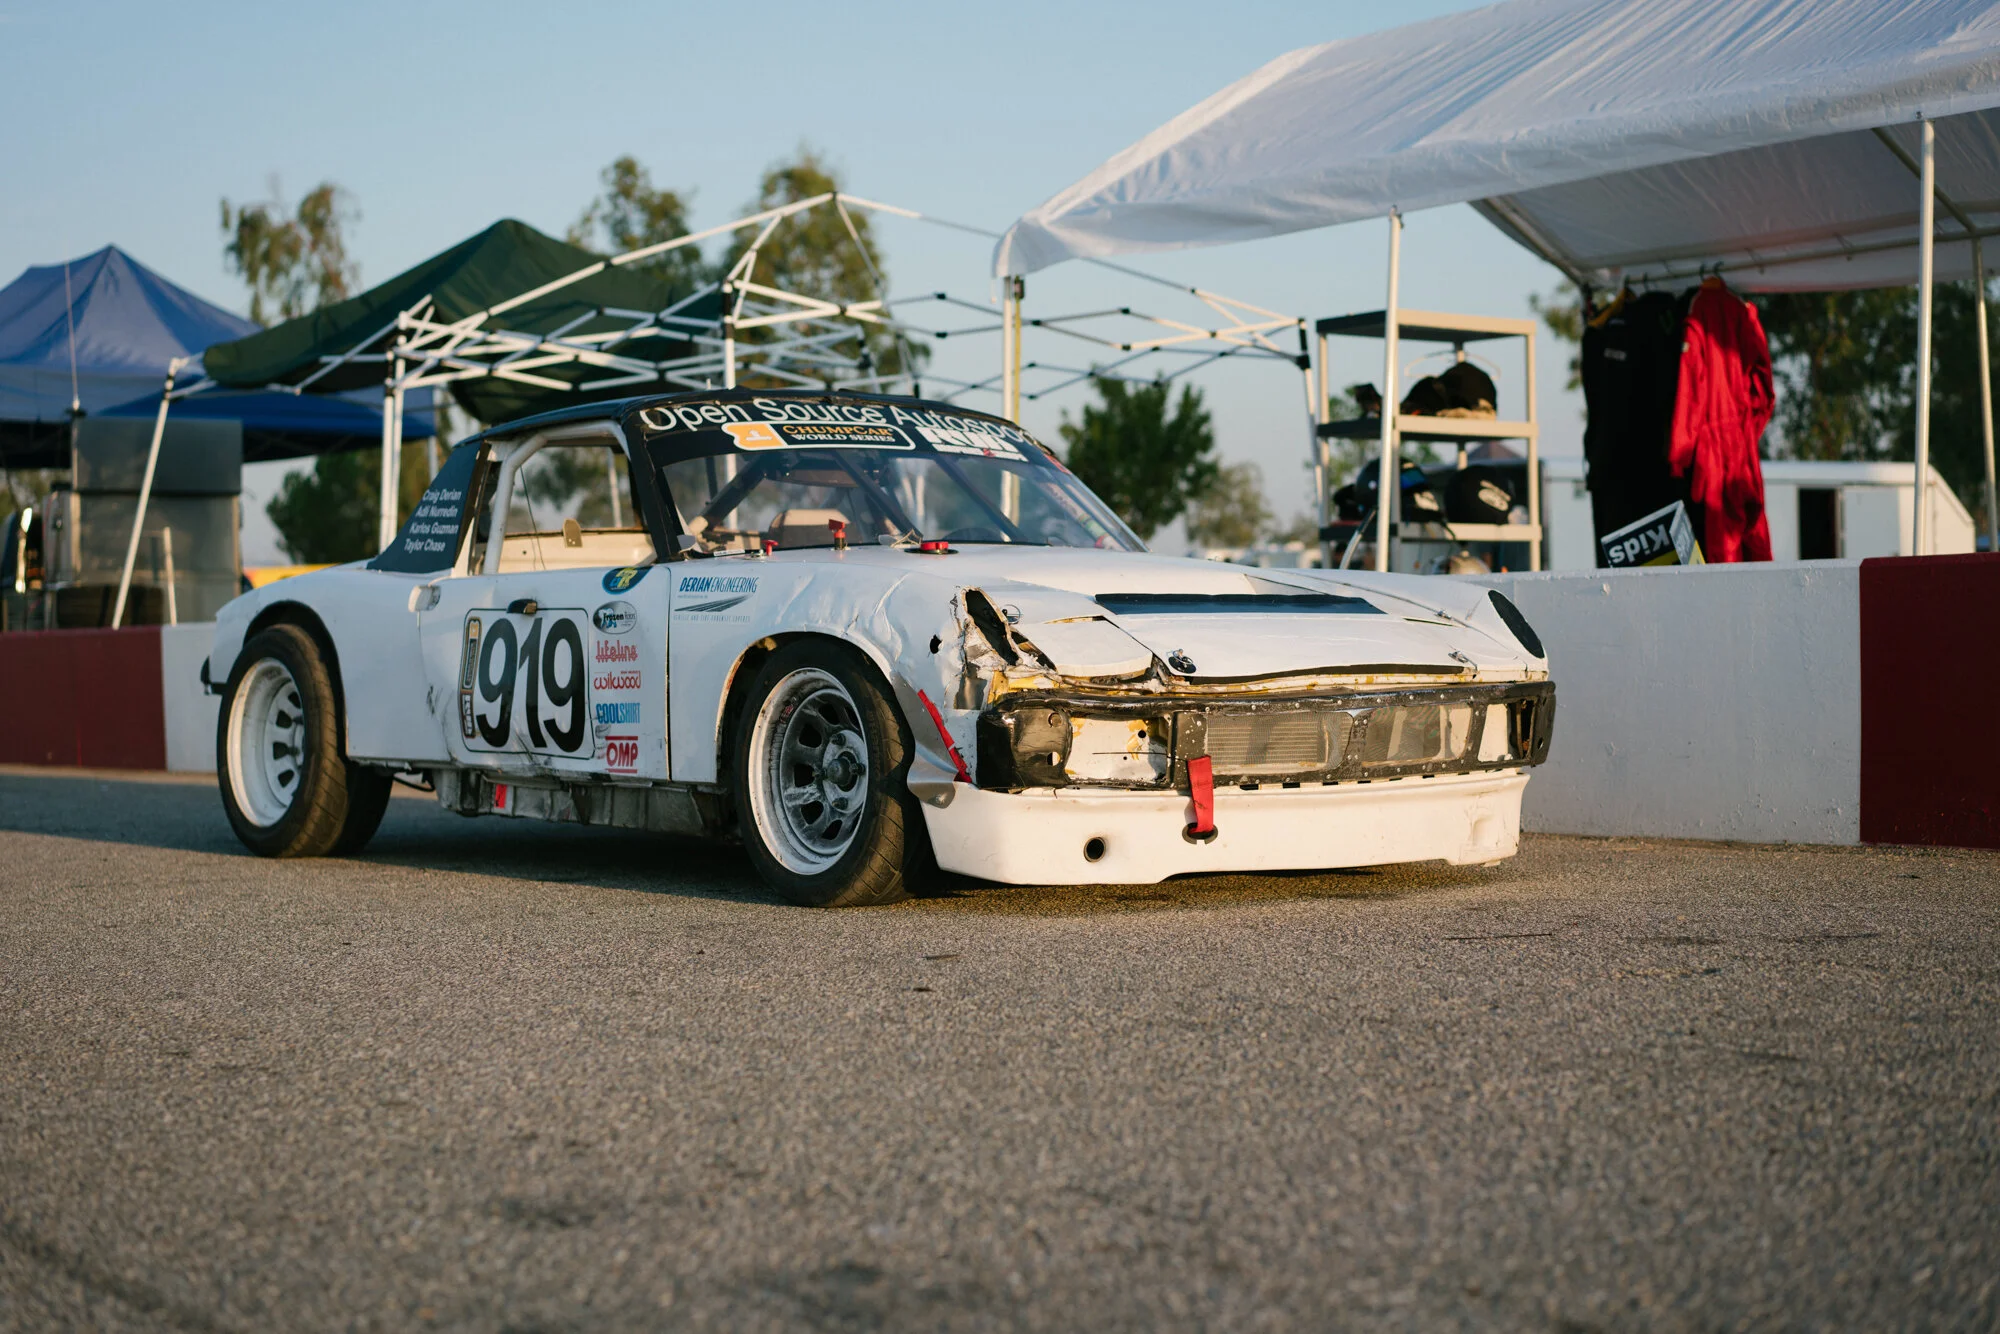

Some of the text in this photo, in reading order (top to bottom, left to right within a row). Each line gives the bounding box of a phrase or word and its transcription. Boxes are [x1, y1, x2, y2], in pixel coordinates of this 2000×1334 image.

[640, 404, 752, 431] Open
[753, 399, 886, 424] Source
[849, 434, 896, 442] SERIES
[1608, 523, 1670, 564] Kids
[476, 617, 585, 753] 919
[593, 670, 641, 690] wilwood
[595, 703, 640, 724] COOLSHIRT
[606, 741, 638, 768] OMP
